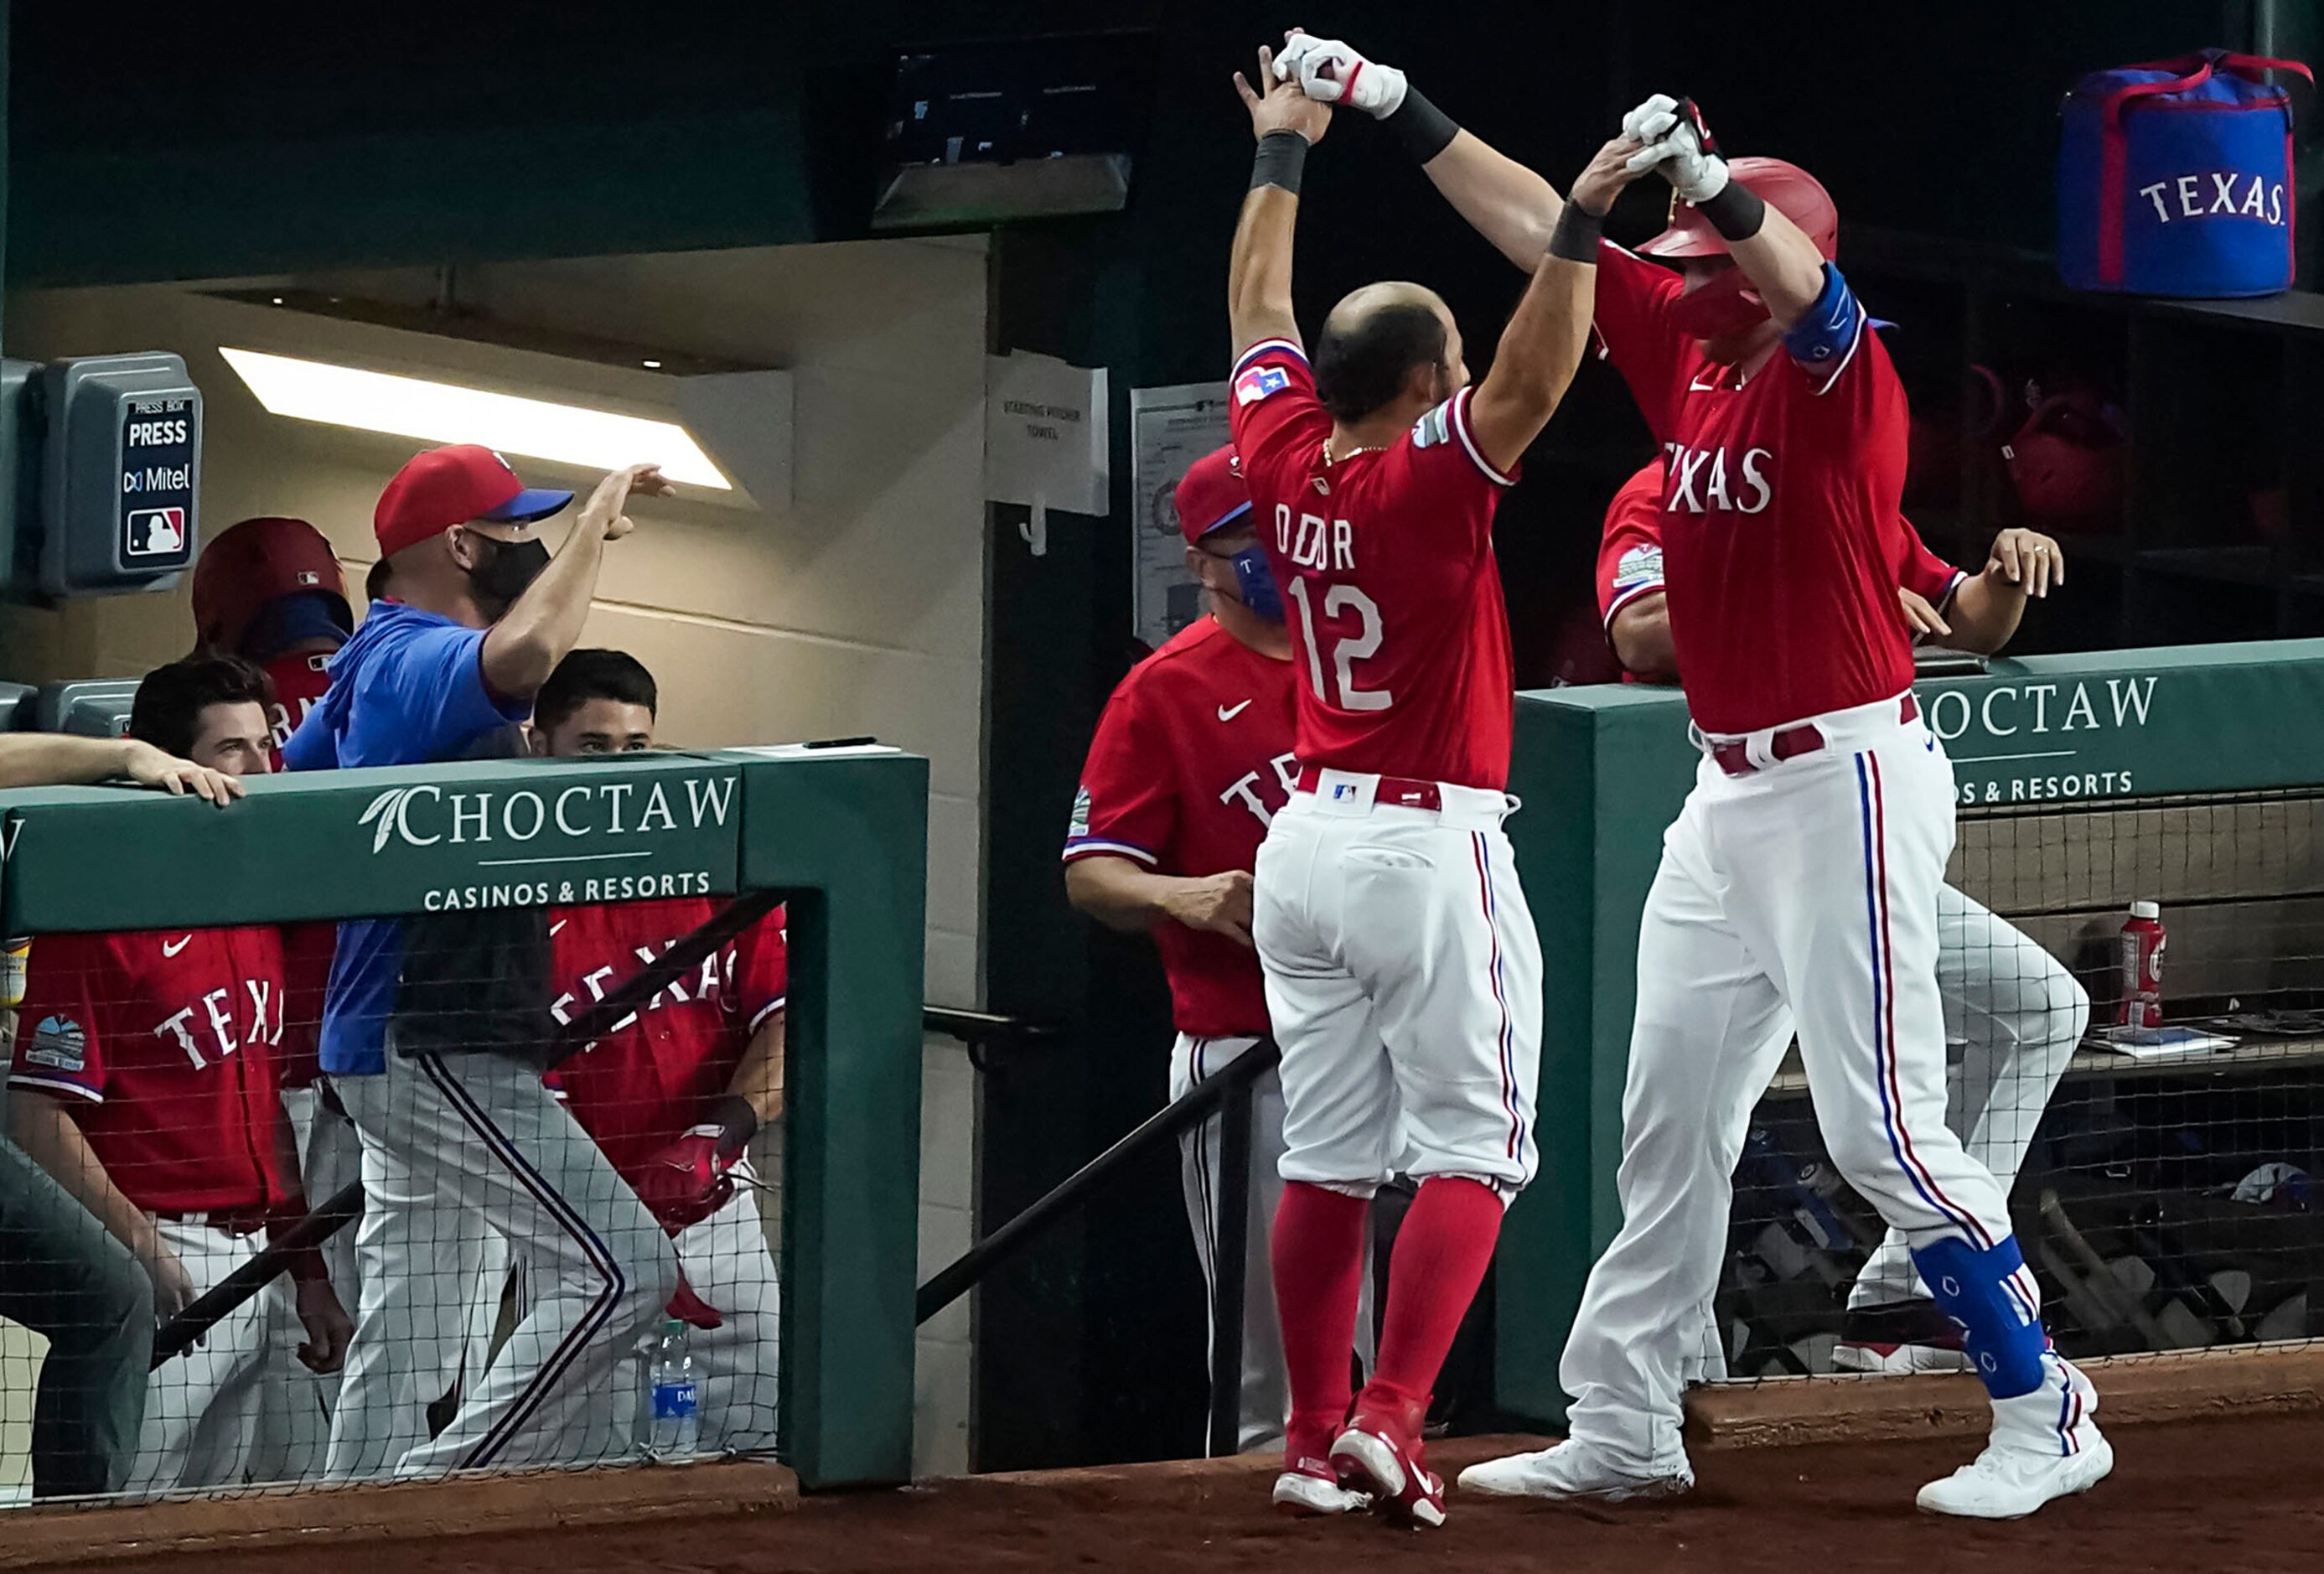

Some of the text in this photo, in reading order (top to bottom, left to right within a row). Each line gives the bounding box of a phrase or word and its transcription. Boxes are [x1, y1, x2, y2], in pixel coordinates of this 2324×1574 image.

[2140, 173, 2285, 225] TEXAS
[135, 400, 184, 413] PRESS BOX
[129, 420, 187, 447] PRESS
[146, 463, 190, 492] Mitel
[1288, 576, 1394, 711] 12
[1917, 676, 2158, 741] OCTAW
[1985, 780, 2001, 802] &
[2011, 770, 2133, 800] RESORTS
[396, 776, 737, 846] CHOCTAW
[423, 872, 710, 911] CASINOS & RESORTS
